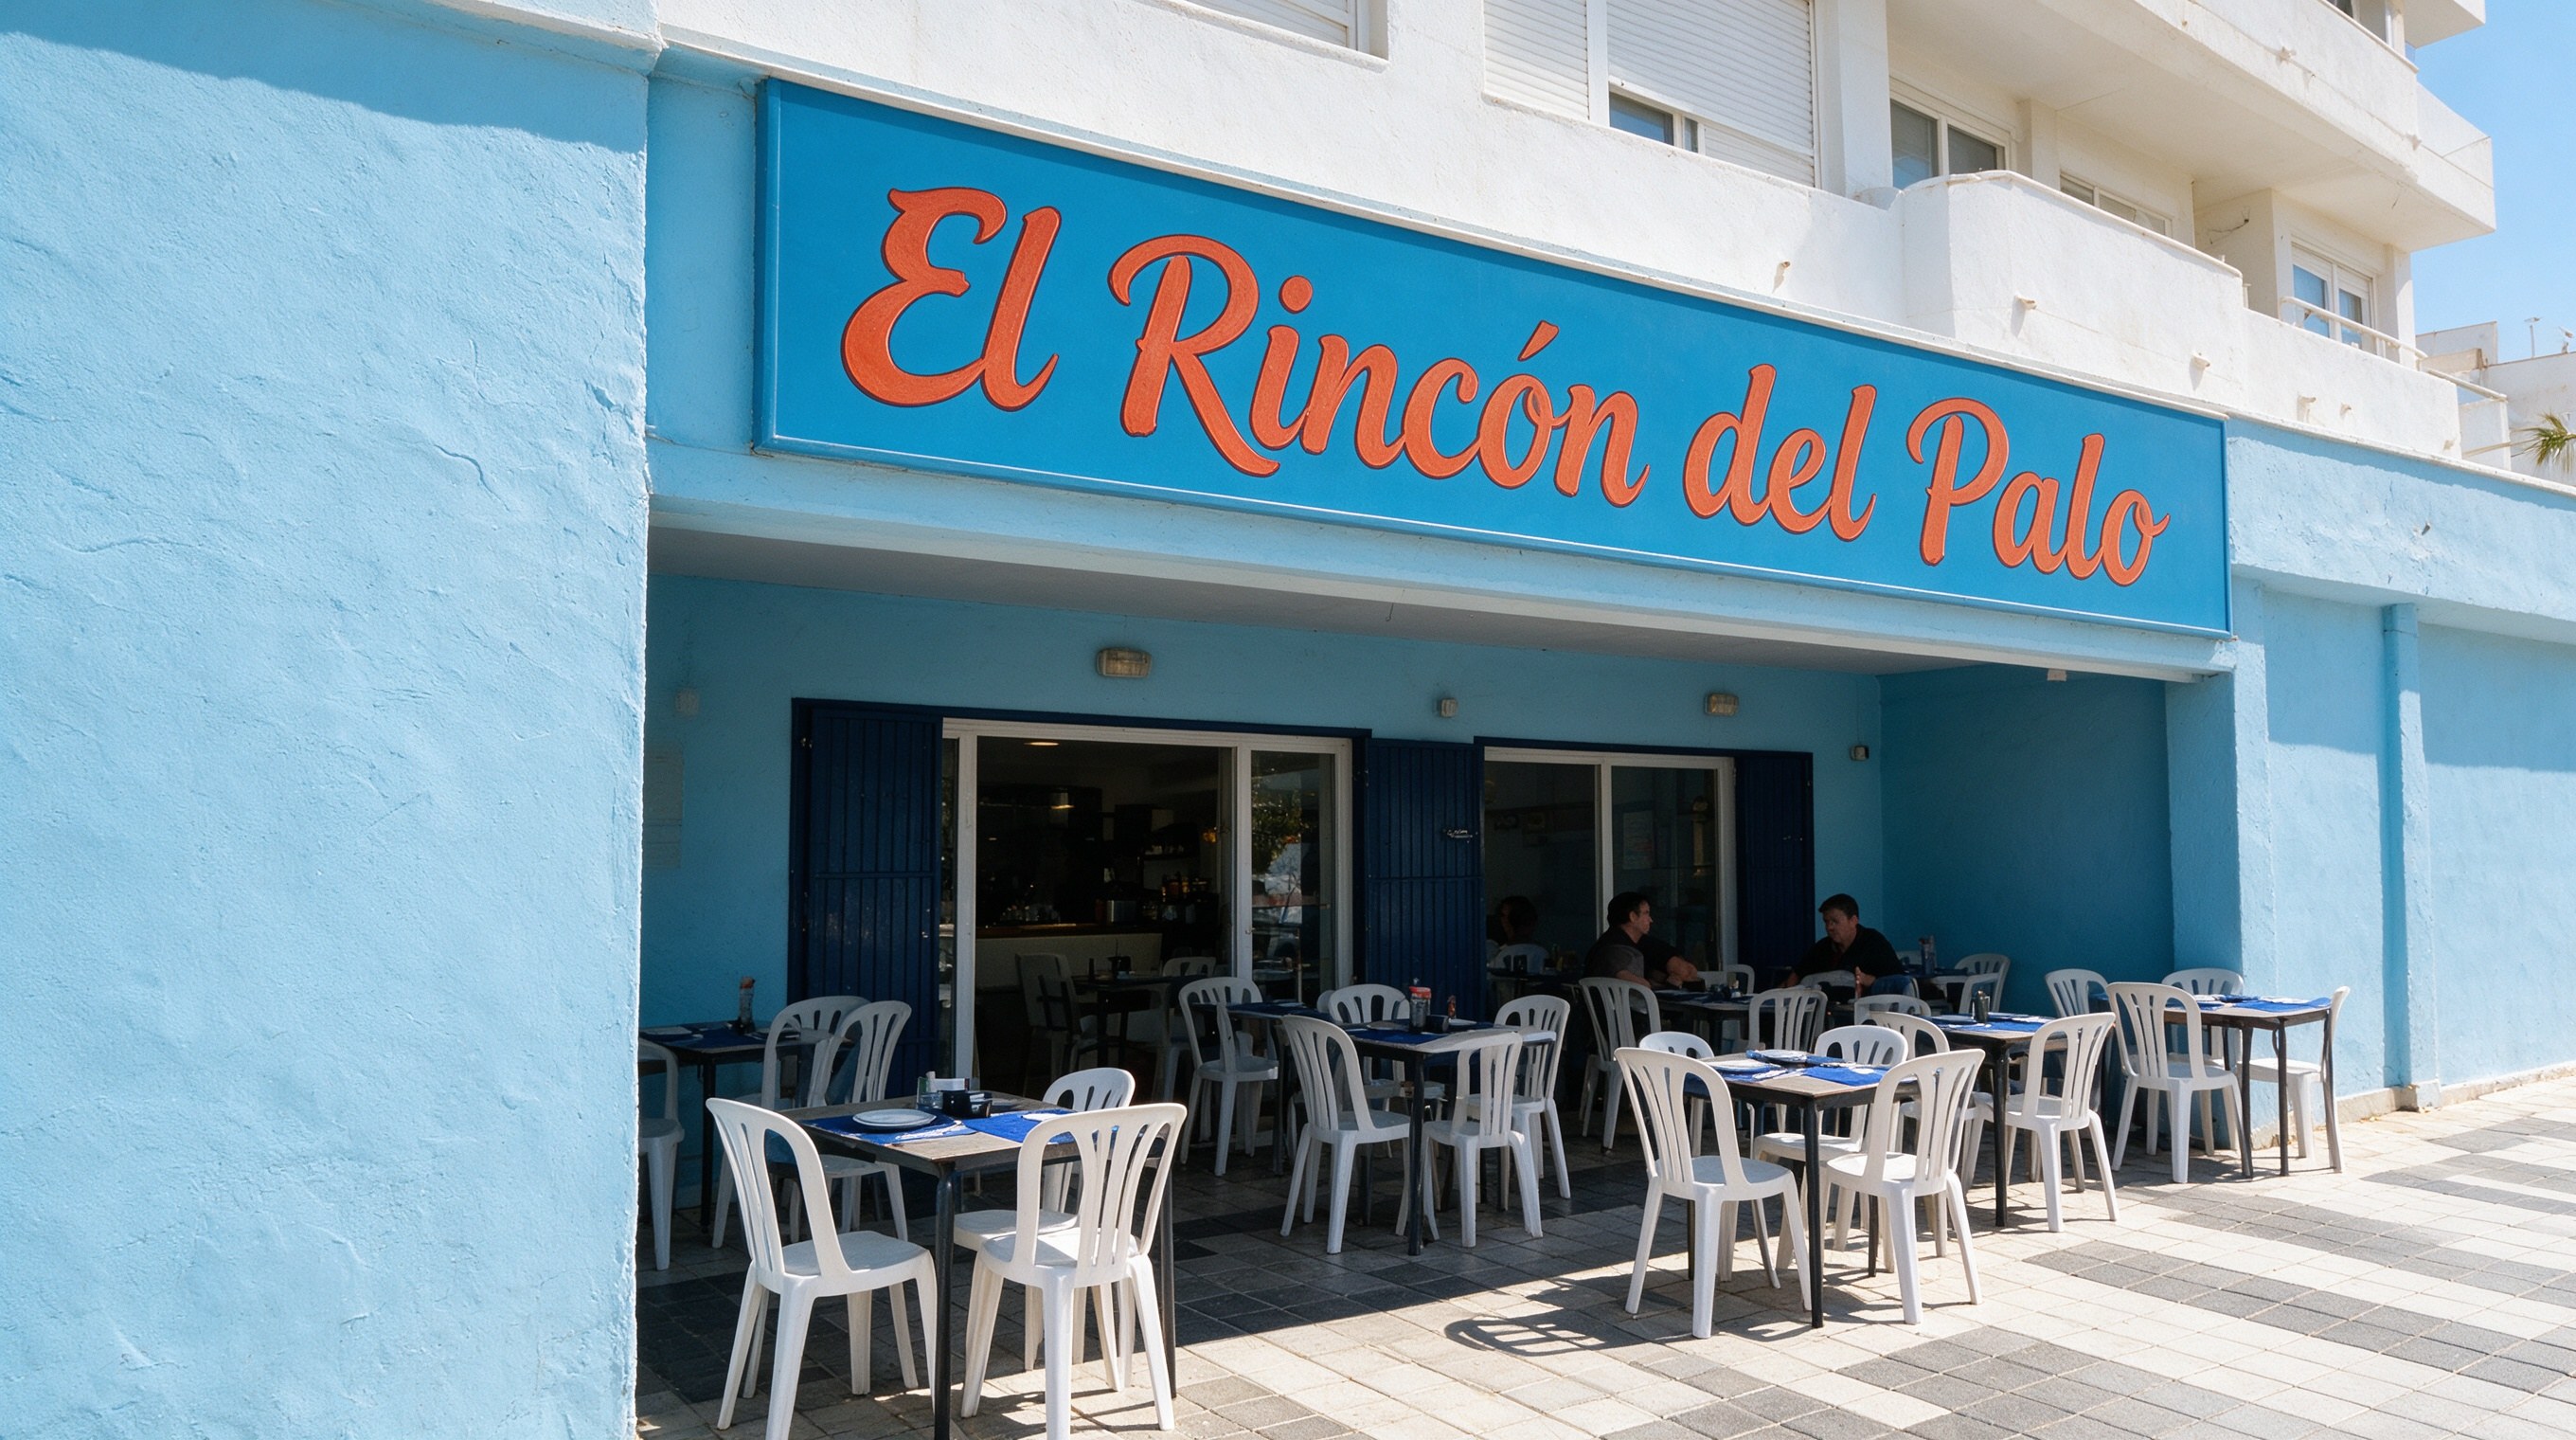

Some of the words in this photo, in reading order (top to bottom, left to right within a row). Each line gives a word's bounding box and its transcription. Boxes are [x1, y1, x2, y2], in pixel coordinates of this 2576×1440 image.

[842, 187, 1062, 411] El
[1108, 233, 1652, 509] Rincón
[1683, 362, 1878, 543] del
[1905, 396, 2172, 588] Palo
